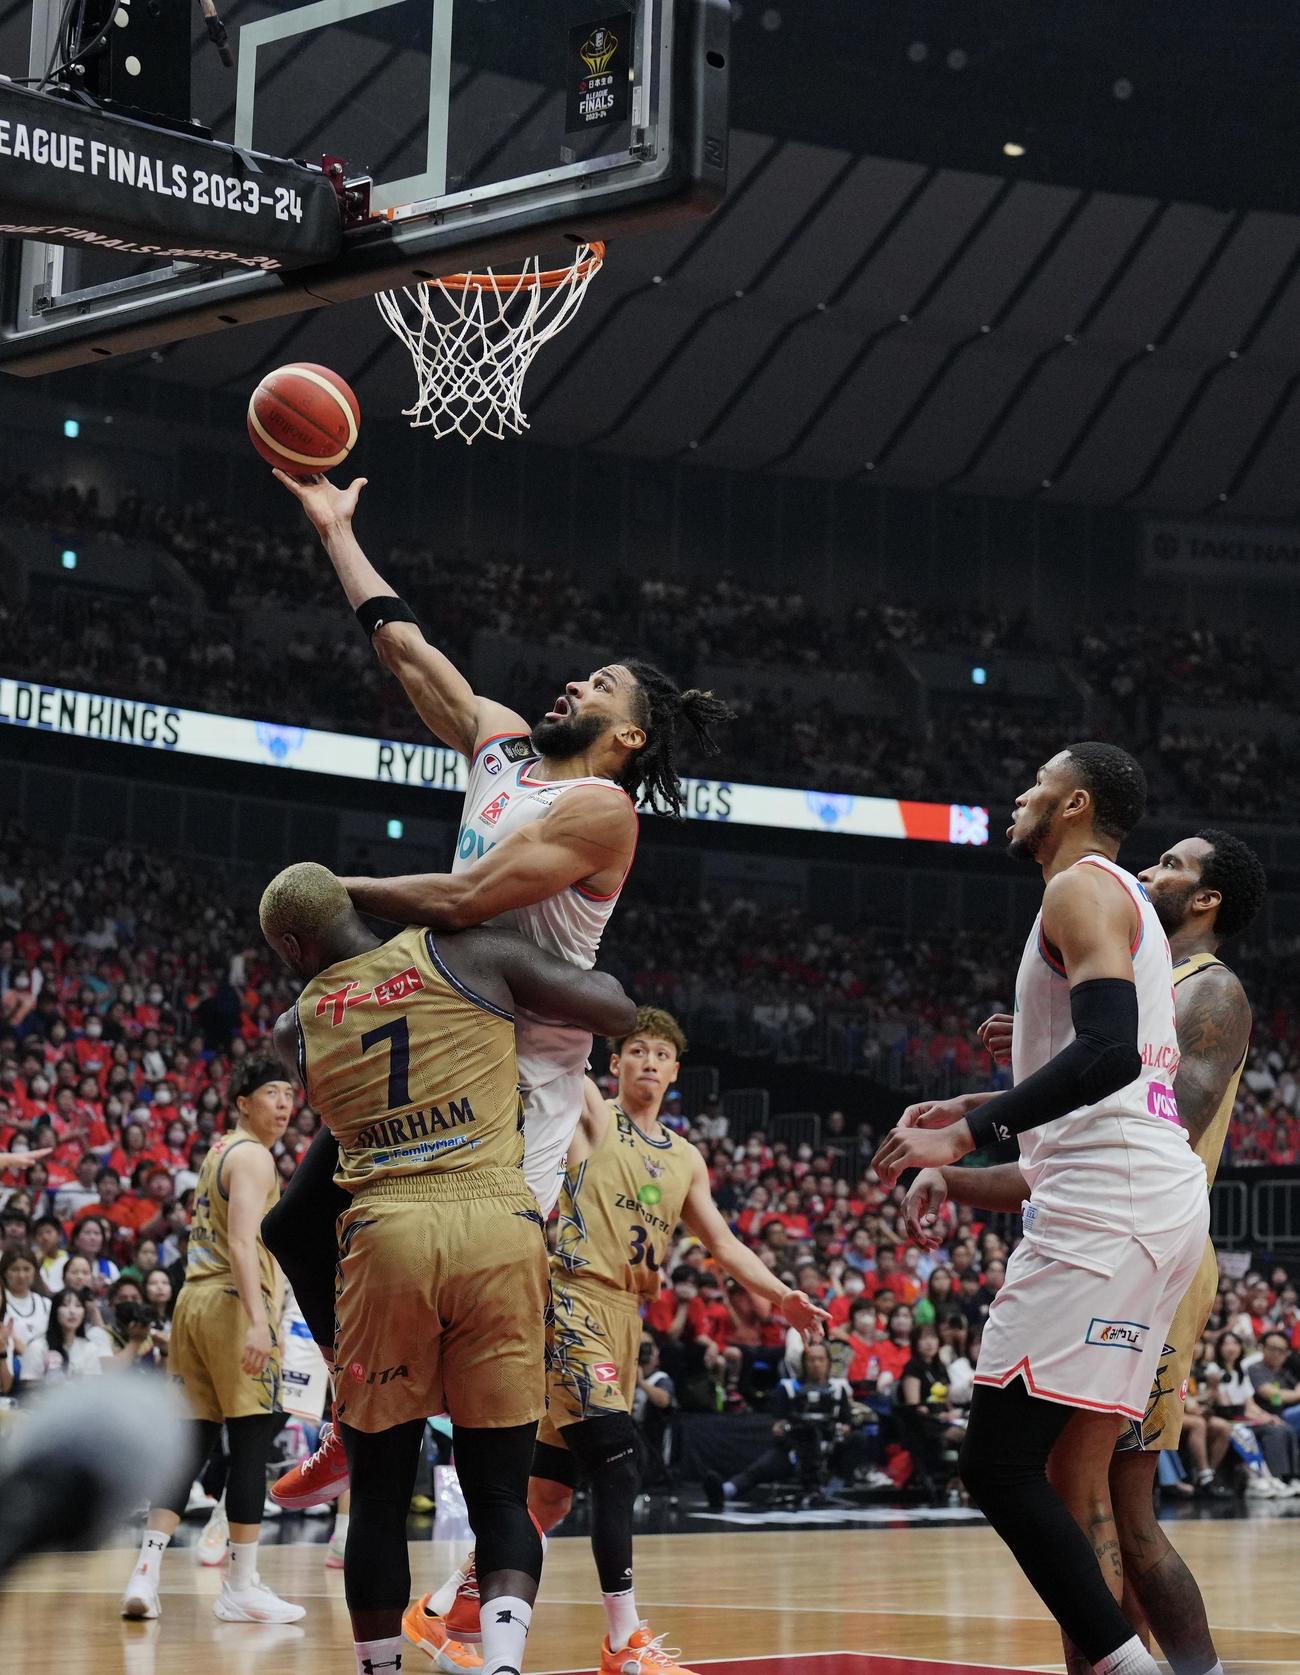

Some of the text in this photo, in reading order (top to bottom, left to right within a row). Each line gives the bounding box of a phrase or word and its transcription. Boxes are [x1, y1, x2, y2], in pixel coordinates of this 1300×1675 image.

[579, 95, 615, 114] FINALS
[91, 141, 187, 198] FINALS
[193, 170, 303, 223] 2023-24
[46, 226, 162, 254] FINALS
[88, 699, 181, 745] KINGS
[361, 1016, 414, 1110] 7
[392, 1135, 467, 1158] FamilyMart
